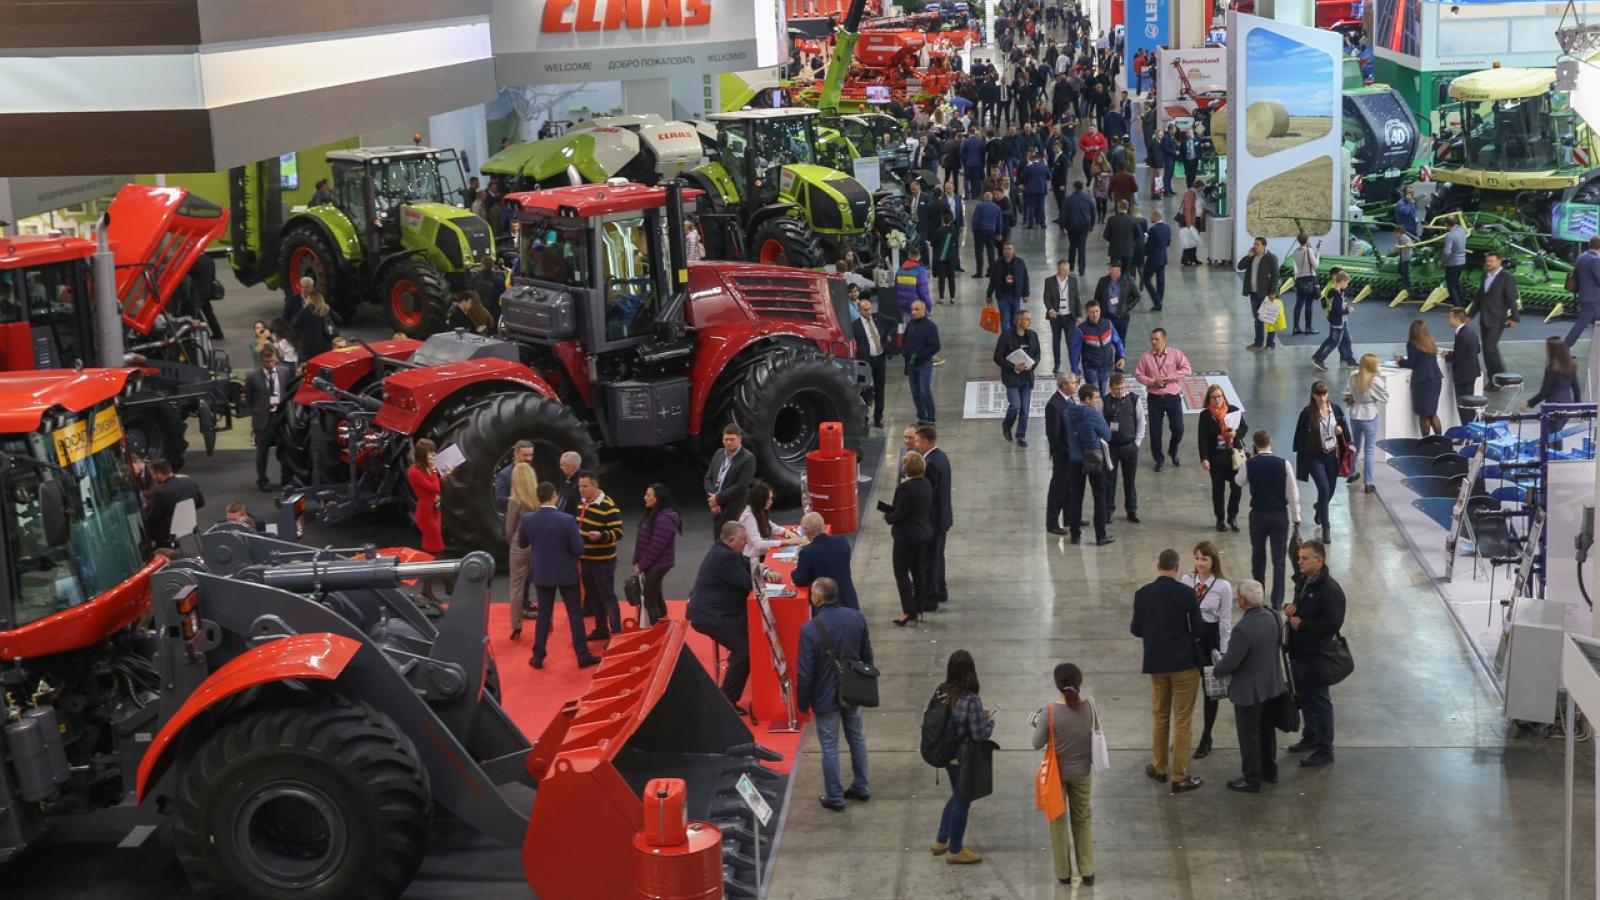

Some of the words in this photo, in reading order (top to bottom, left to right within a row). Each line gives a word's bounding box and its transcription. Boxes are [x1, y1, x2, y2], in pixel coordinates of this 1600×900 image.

[540, 0, 711, 33] CLAAS
[1145, 0, 1158, 22] LE
[544, 61, 593, 72] WELCOME
[608, 59, 640, 71] ДОБРО
[641, 55, 696, 67] ПОЖАЛОВАТЬ
[657, 131, 692, 140] CLAAS
